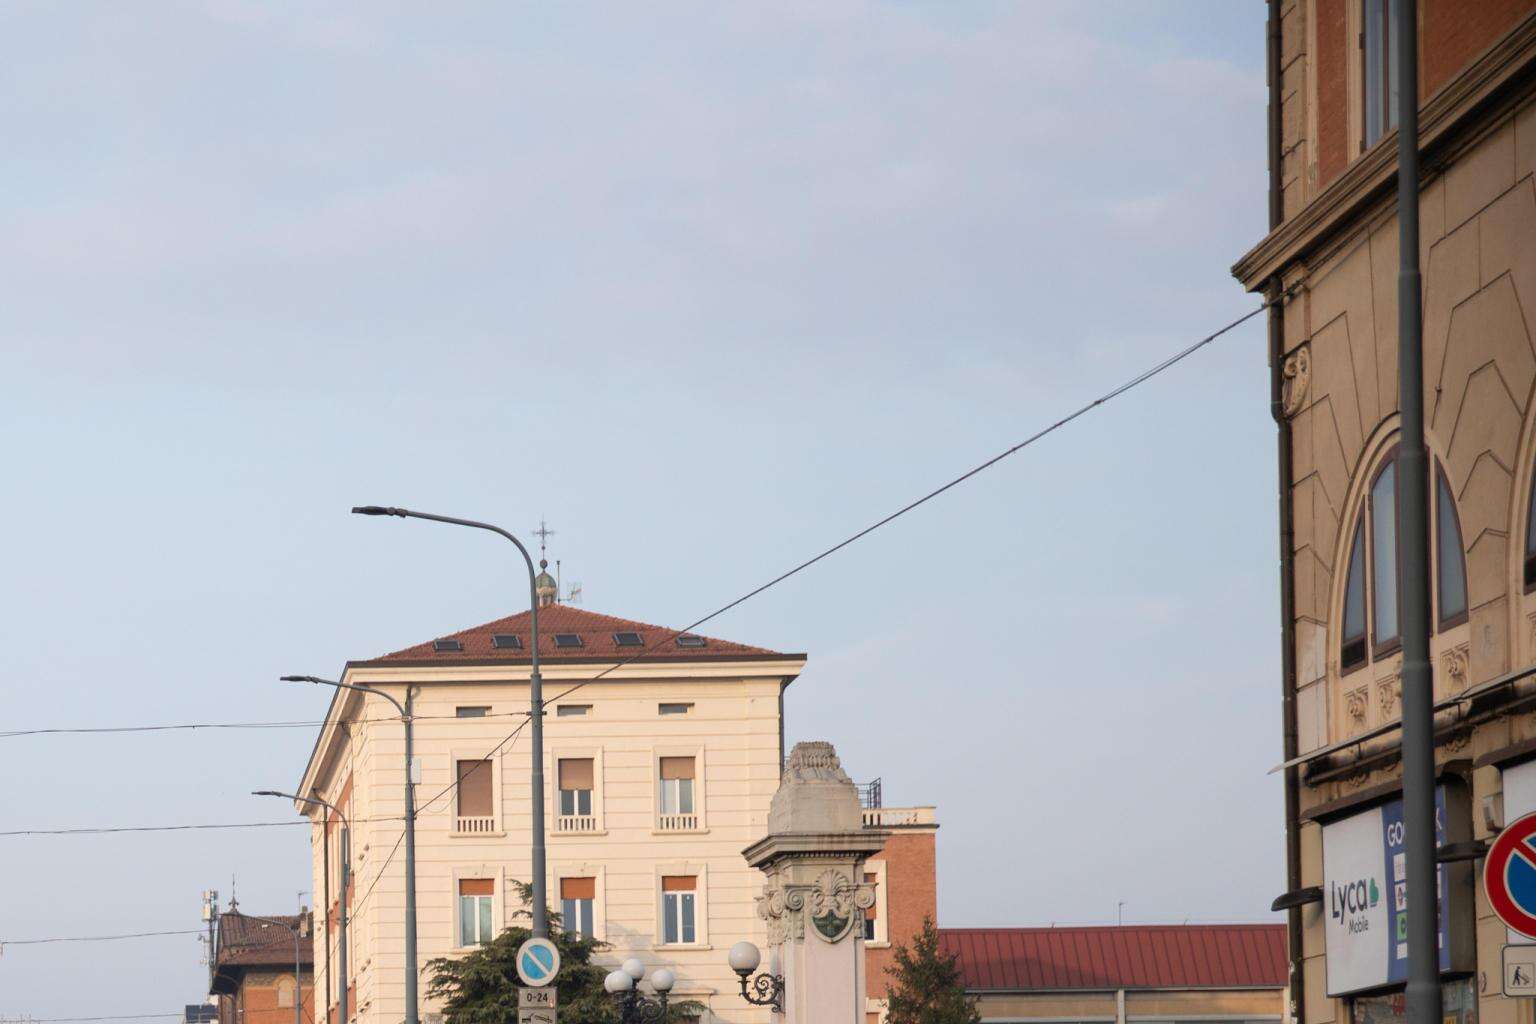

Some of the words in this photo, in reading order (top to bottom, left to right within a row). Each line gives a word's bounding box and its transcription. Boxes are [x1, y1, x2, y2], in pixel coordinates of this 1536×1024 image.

[1332, 878, 1368, 924] Lyca
[1348, 915, 1369, 936] Mobile
[526, 992, 548, 1003] 0-24
